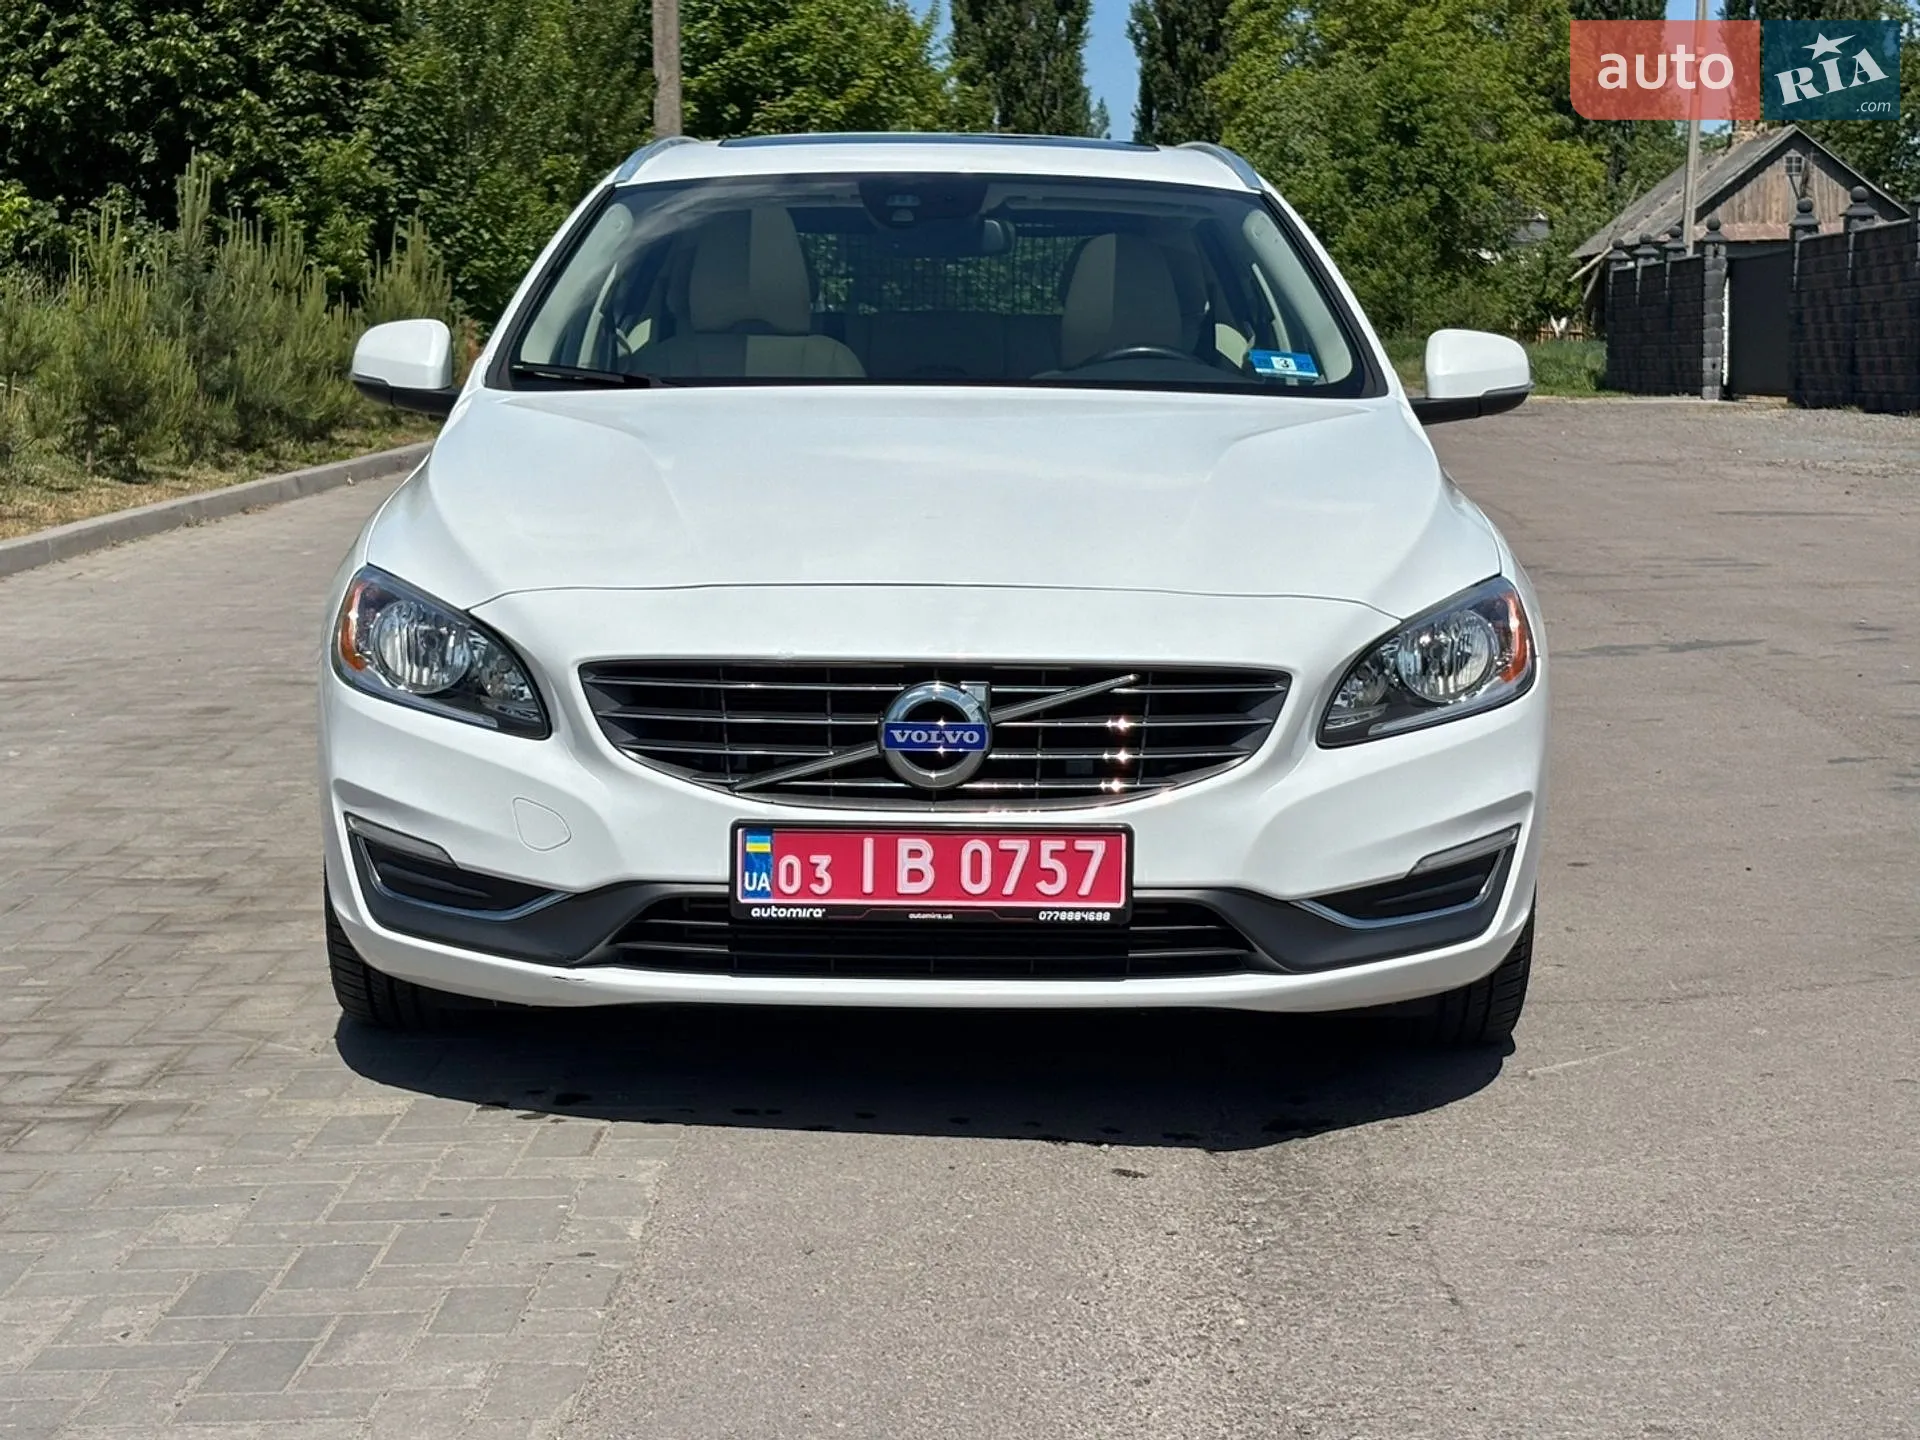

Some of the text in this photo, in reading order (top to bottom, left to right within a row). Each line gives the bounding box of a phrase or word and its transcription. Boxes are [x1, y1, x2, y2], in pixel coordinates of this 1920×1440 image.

[890, 730, 980, 743] VOLVO
[778, 854, 832, 894] 03
[960, 838, 1106, 896] 0757
[744, 872, 771, 892] UA
[751, 905, 822, 918] automira
